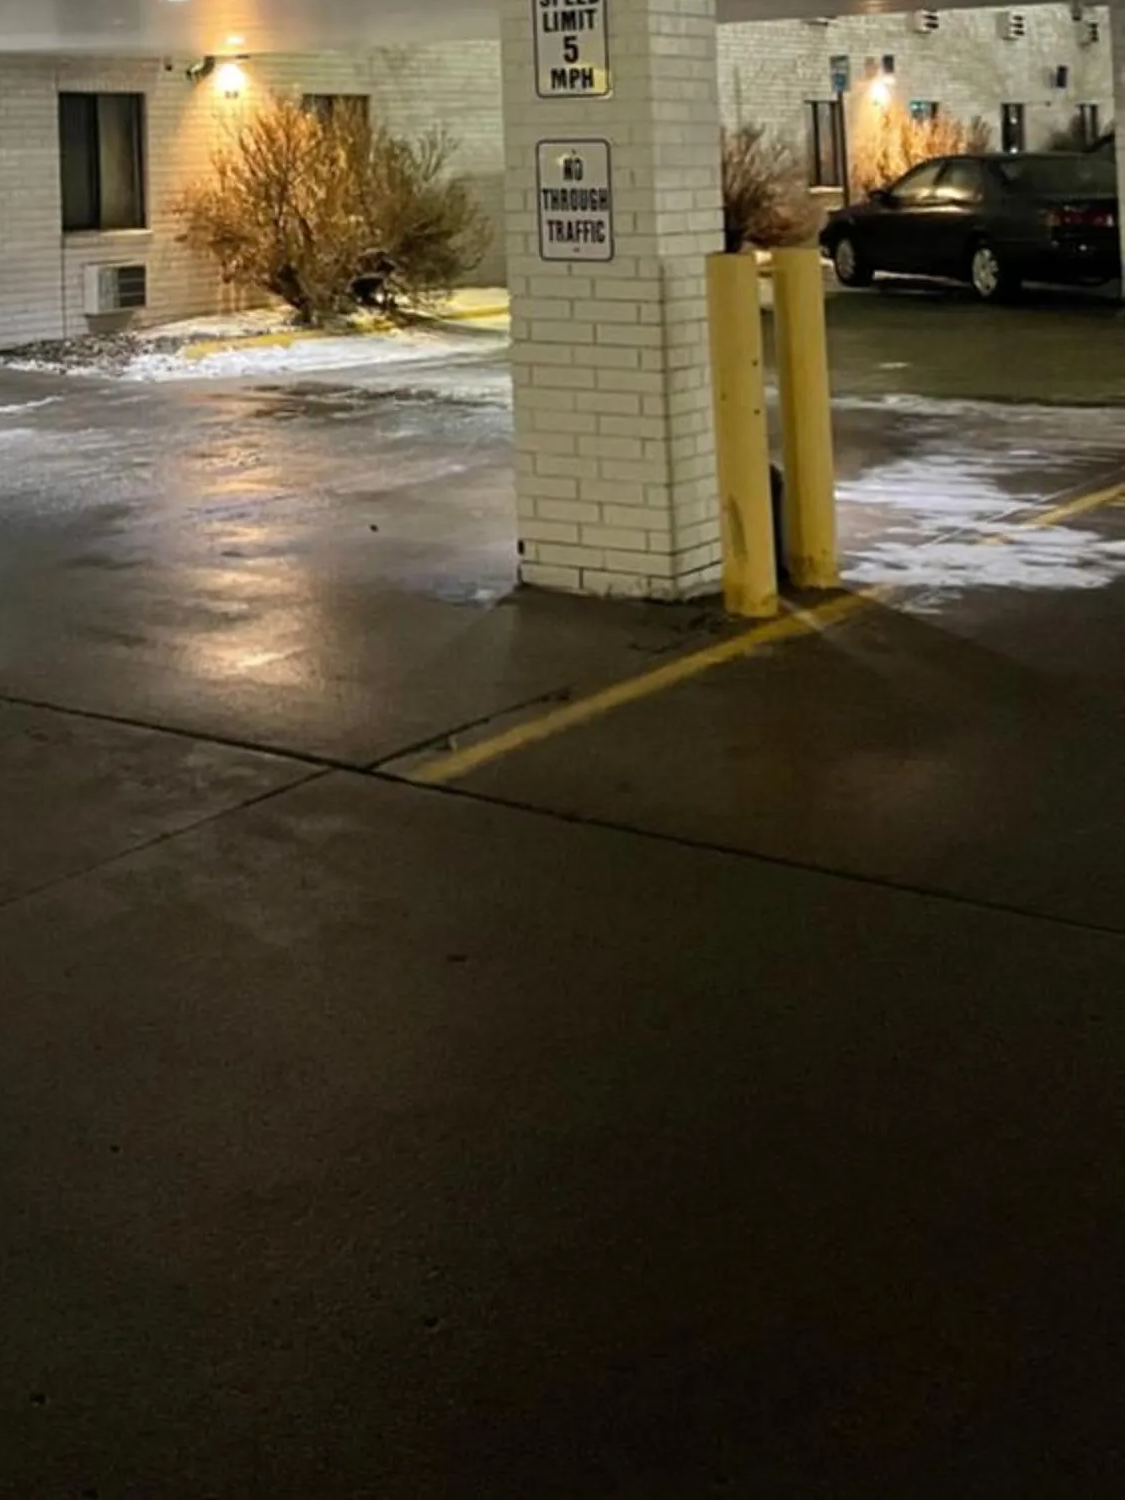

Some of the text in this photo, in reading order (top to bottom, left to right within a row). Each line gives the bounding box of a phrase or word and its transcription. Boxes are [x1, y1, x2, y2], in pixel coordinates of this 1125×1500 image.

[542, 8, 597, 33] LIMIT
[563, 35, 579, 64] 5
[550, 67, 594, 89] MPH
[563, 157, 583, 182] NO
[542, 187, 609, 212] THROUGH
[546, 219, 605, 243] TRAFFIC
